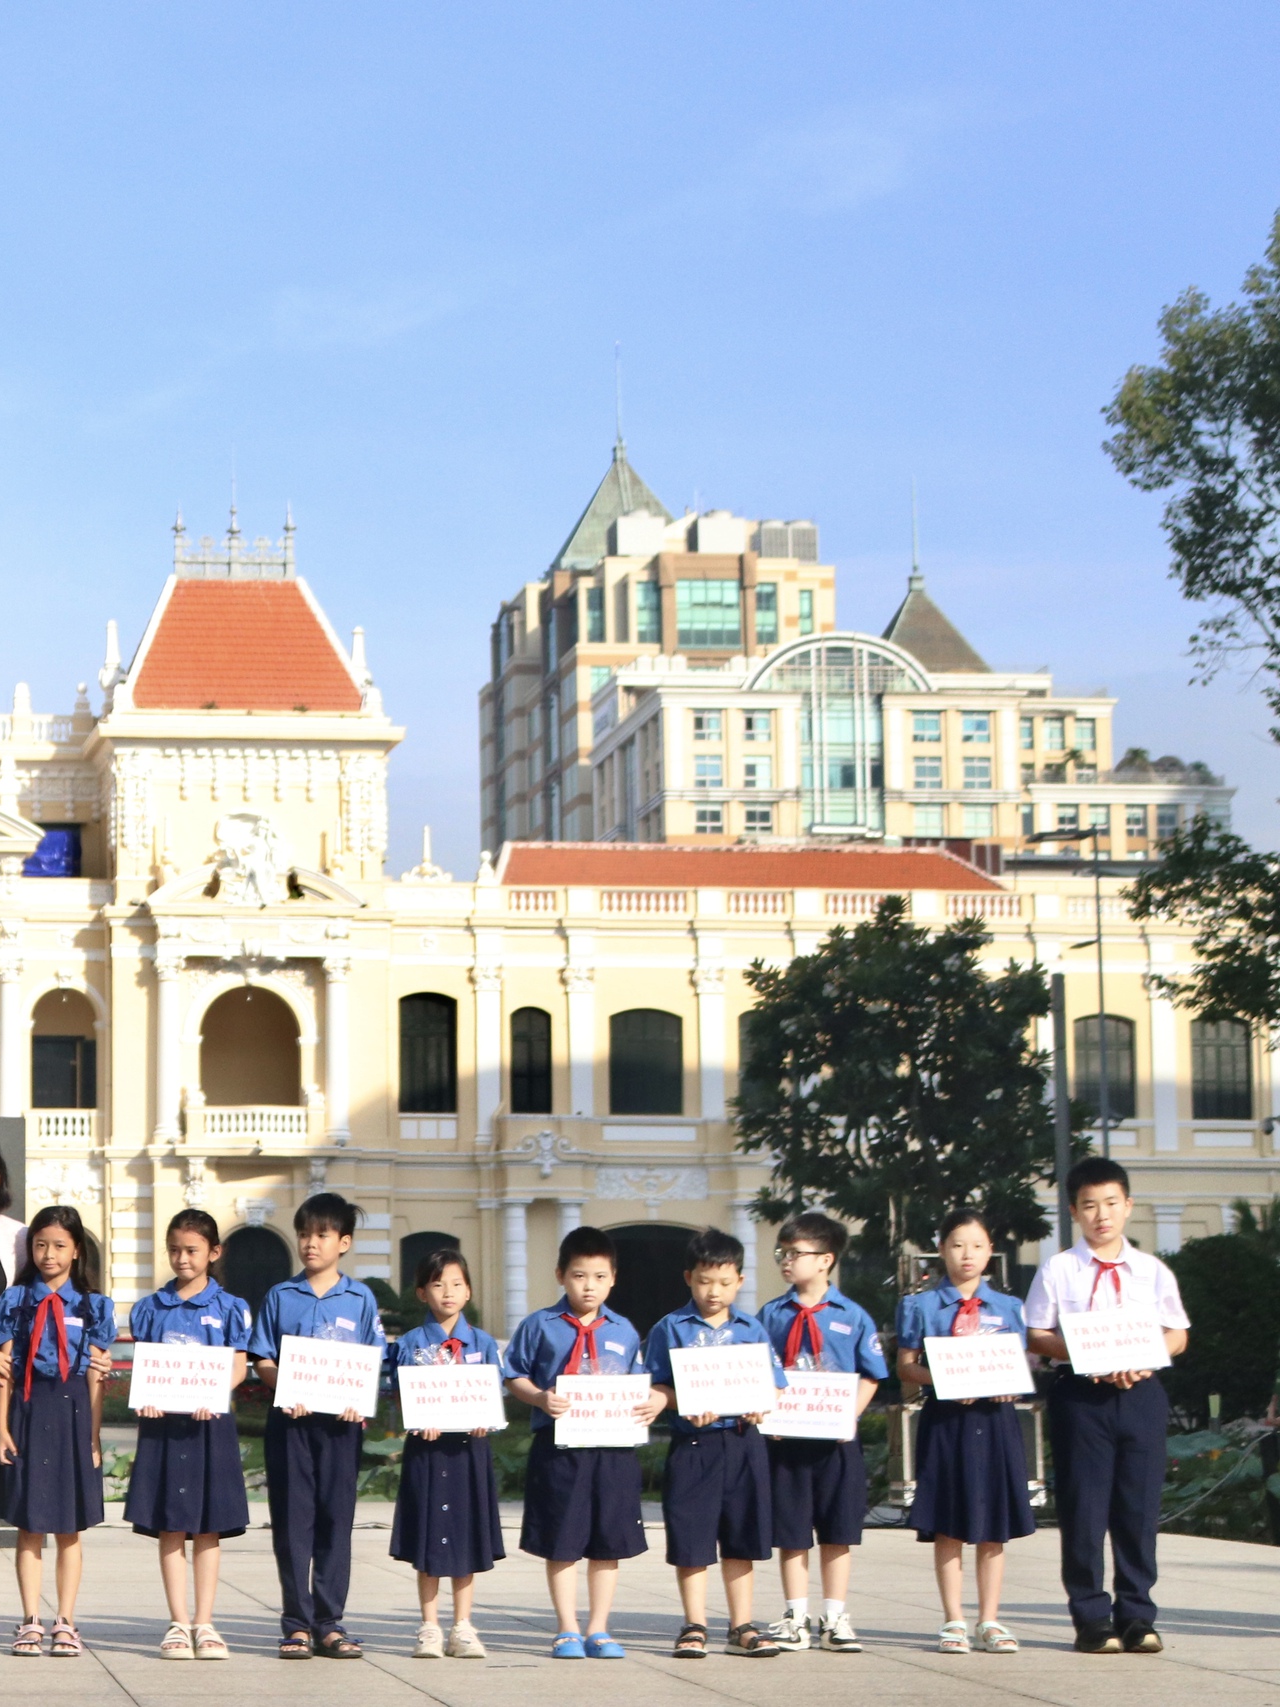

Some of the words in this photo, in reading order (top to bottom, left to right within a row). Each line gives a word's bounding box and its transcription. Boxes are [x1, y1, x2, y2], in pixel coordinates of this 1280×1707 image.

[142, 1358, 181, 1369] TRAO
[289, 1353, 328, 1367] TRAO
[408, 1380, 448, 1390] TRAO
[563, 1391, 604, 1401] TRAO
[780, 1387, 807, 1396] AO
[604, 1404, 633, 1419] BỔN
